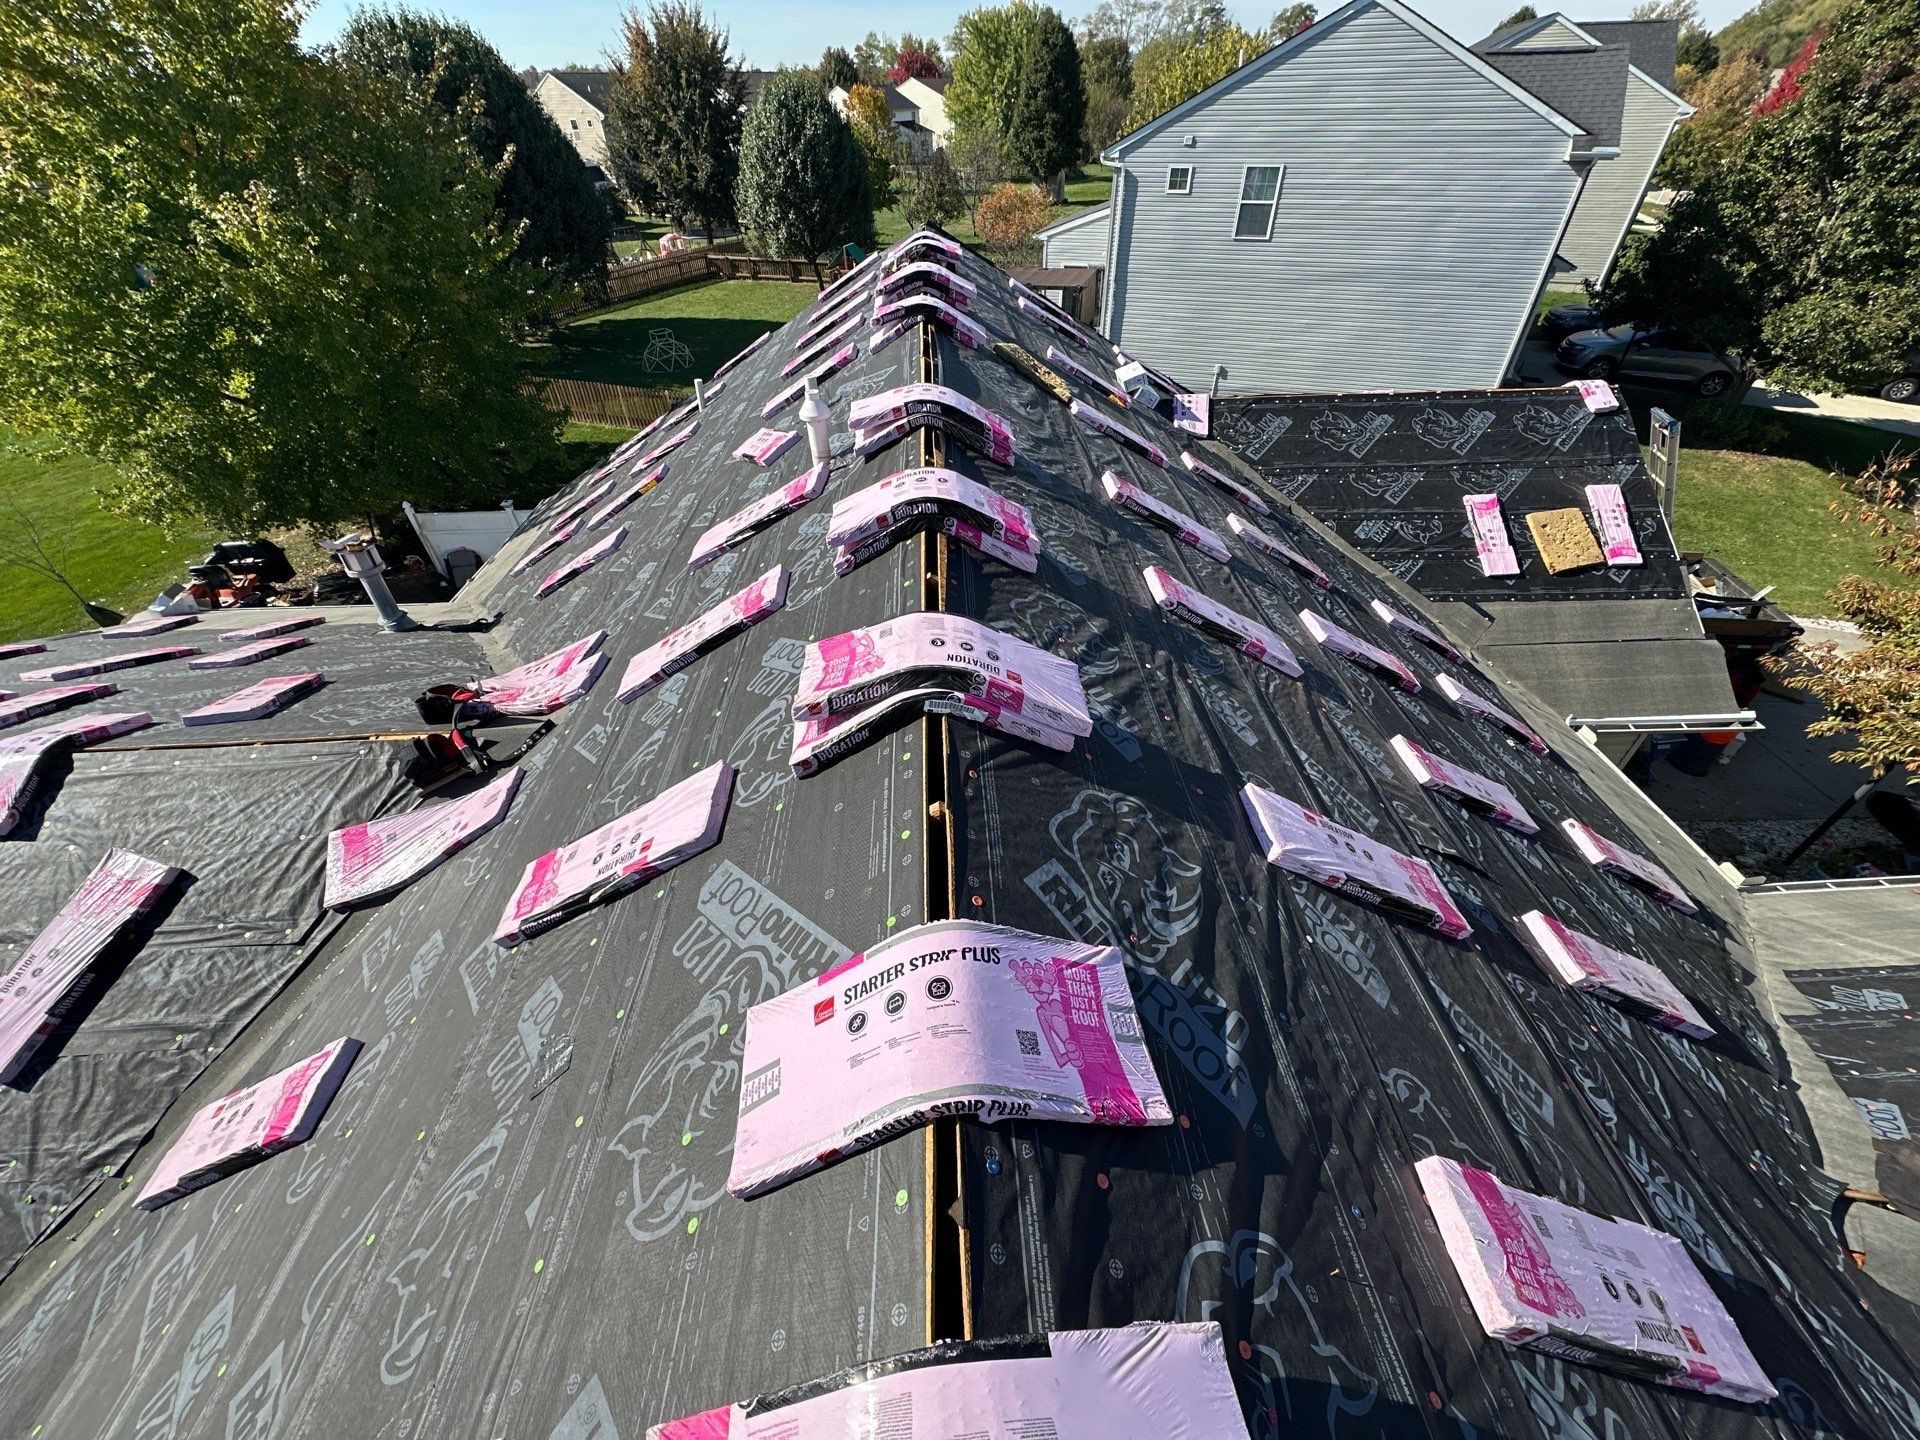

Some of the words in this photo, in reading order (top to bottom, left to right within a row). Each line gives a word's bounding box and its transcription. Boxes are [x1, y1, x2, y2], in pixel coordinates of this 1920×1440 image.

[908, 403, 941, 414] DURATION
[1360, 411, 1378, 429] U20
[1461, 408, 1480, 426] U20
[1561, 405, 1580, 424] U20
[910, 417, 944, 427] DURATION
[1258, 413, 1277, 431] U20
[1456, 413, 1492, 453] RhinoRoof
[1353, 416, 1390, 455] RhinoRoof
[894, 502, 938, 519] DURATION
[856, 537, 890, 563] DURATION
[1176, 608, 1203, 625] DURATION
[665, 651, 699, 675] DURATION
[947, 653, 1000, 675] DURATION
[747, 668, 789, 697] U20
[832, 682, 891, 710] DURATION
[817, 728, 870, 762] DURATION
[597, 849, 636, 878] DURATION
[1315, 895, 1375, 952] U20
[672, 915, 731, 983] U20
[1, 954, 37, 994] DURATION
[844, 962, 905, 1005] STARTER
[962, 947, 1000, 964] PLUS
[1063, 968, 1092, 982] MORE
[57, 973, 96, 1015] DURATION
[1066, 980, 1095, 998] THAN
[1070, 996, 1089, 1009] JUST
[1091, 1002, 1097, 1010] A
[1171, 959, 1250, 1052] U20
[1072, 1010, 1100, 1027] ROOF
[854, 1111, 929, 1146] STARTER
[930, 1099, 985, 1118] STRIP
[988, 1100, 1032, 1117] PLUS
[1510, 1264, 1539, 1288] THAN
